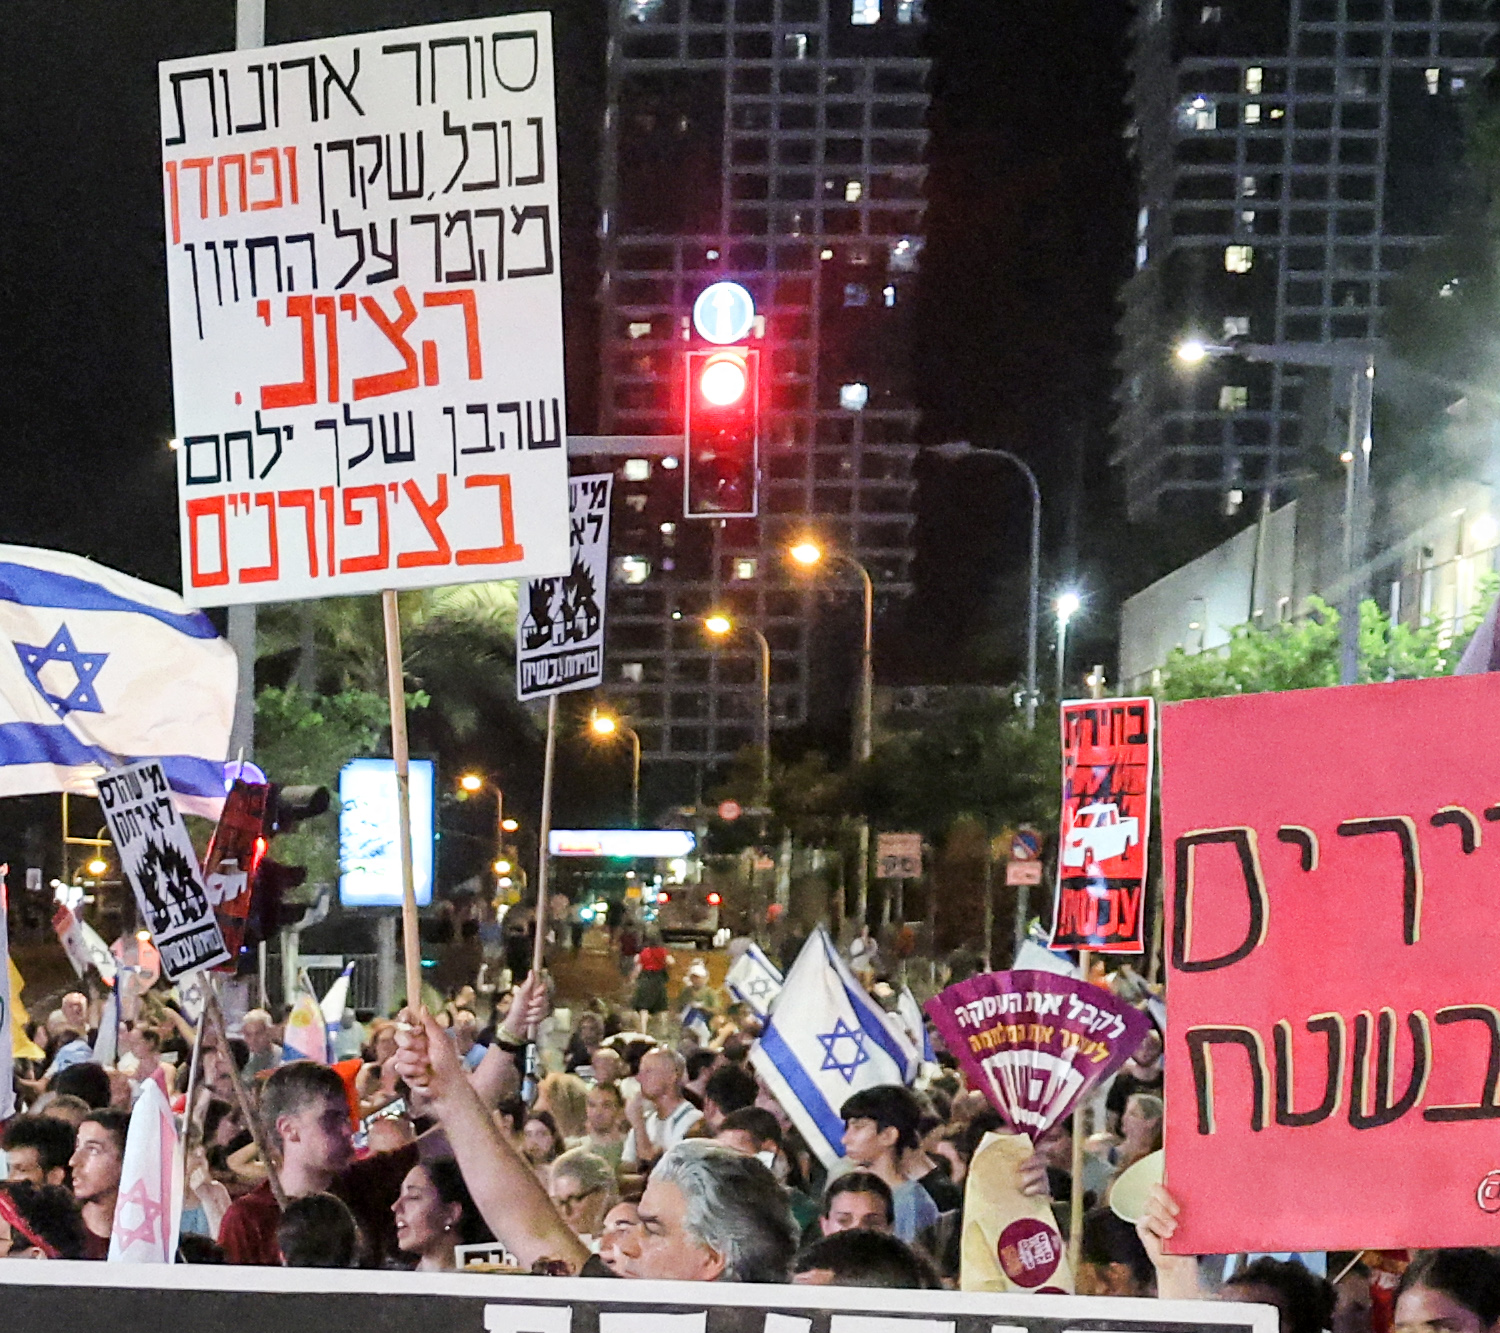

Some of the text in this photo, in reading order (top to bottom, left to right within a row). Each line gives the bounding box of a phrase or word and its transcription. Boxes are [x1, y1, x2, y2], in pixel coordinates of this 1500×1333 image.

[165, 30, 538, 146] סוחר ארונות
[165, 146, 299, 245] ופחדן
[314, 130, 424, 224] שקרן
[184, 204, 554, 340] מהמר על החזון
[184, 398, 562, 487] שהבן שלך ילחם
[186, 473, 525, 588] בציפורניים
[97, 764, 166, 808] מי שהרס
[147, 797, 175, 830] לא
[954, 991, 1126, 1038] לקבל את העסקה
